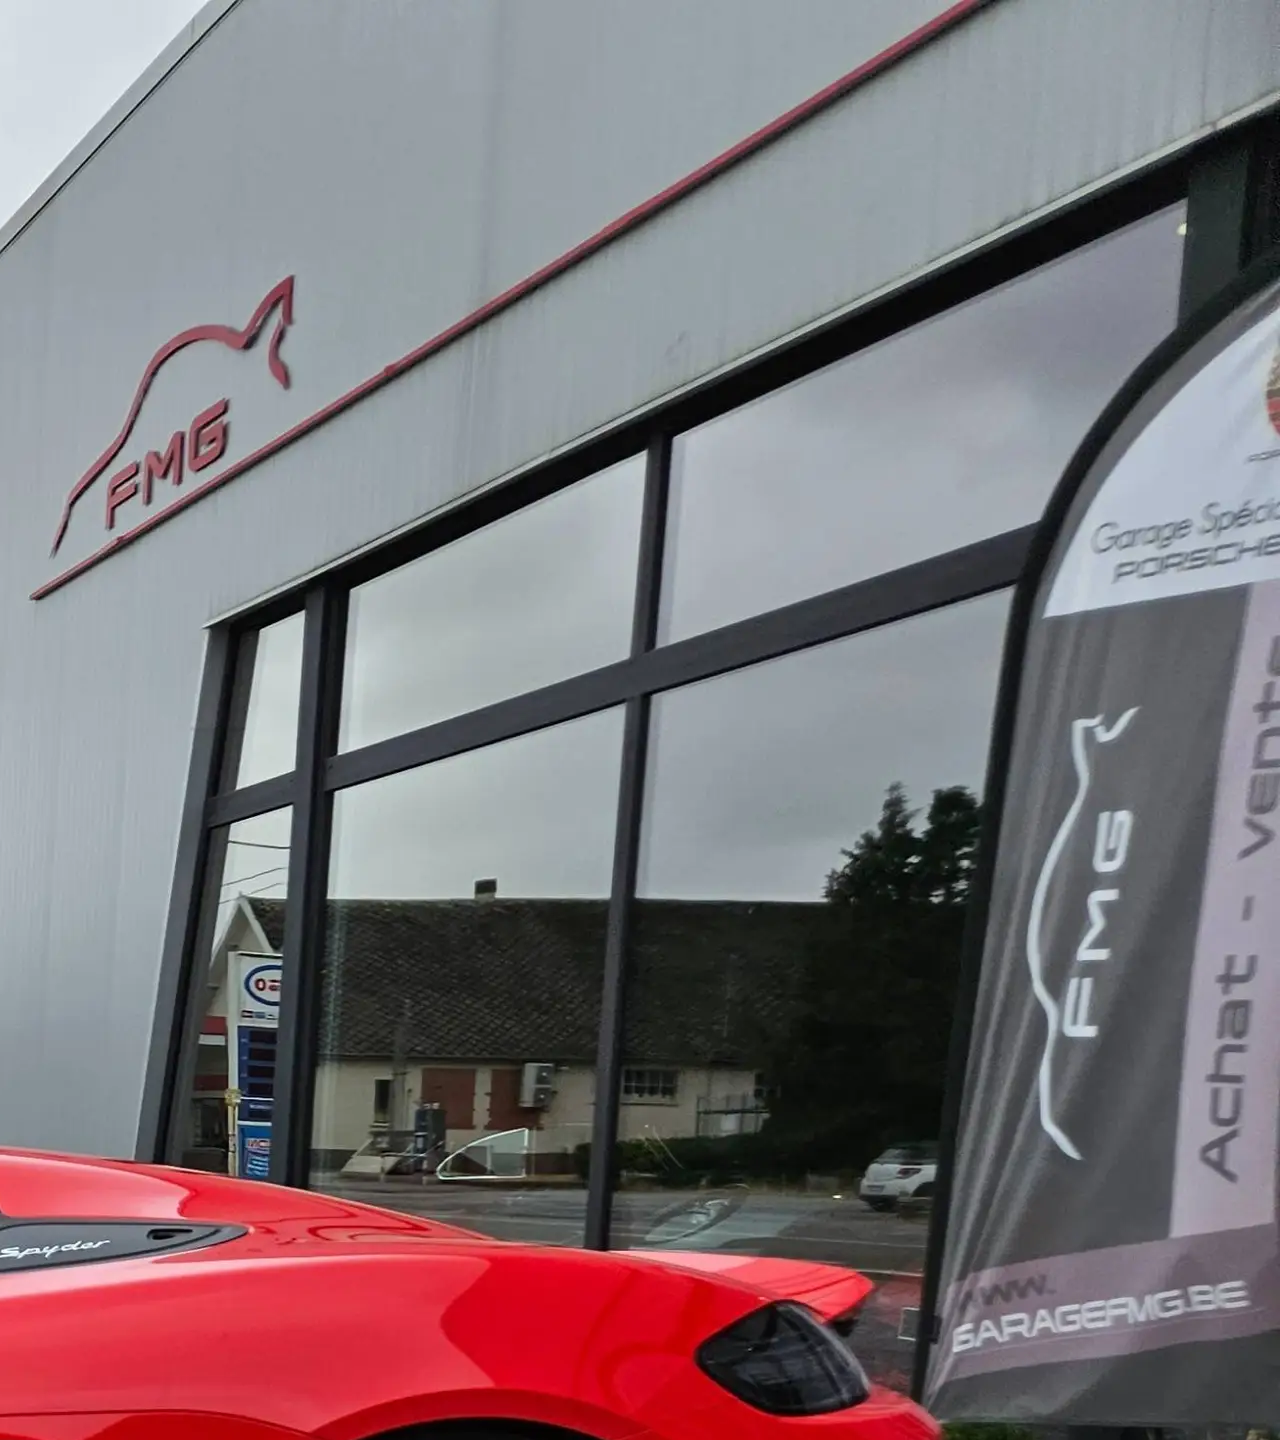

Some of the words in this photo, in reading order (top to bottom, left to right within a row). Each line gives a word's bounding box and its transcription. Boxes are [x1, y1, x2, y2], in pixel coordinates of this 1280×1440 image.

[105, 397, 231, 531] FMG
[1091, 520, 1192, 555] Garage
[1062, 809, 1134, 1038] FMG
[1200, 954, 1259, 1184] Achat
[951, 1280, 1252, 1353] GARAGEFMG.BE
